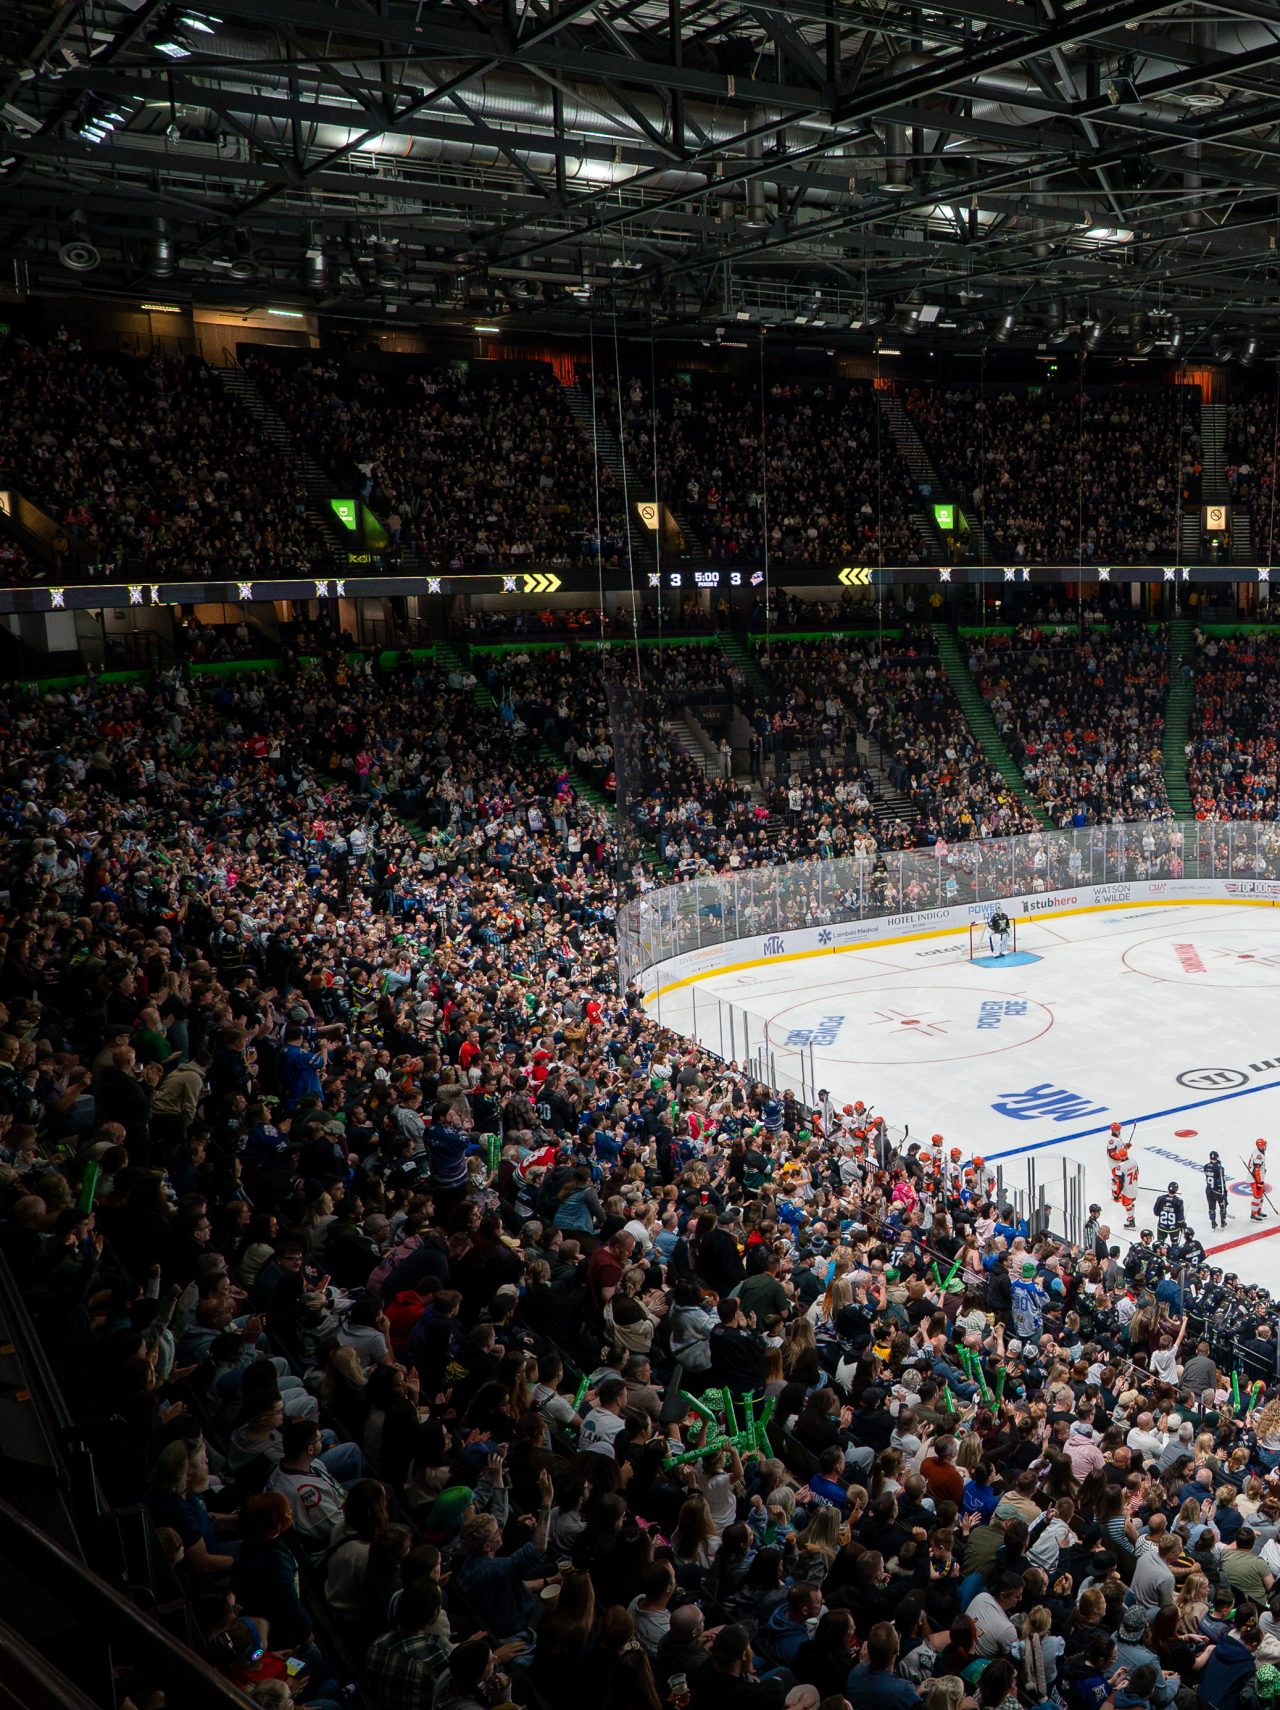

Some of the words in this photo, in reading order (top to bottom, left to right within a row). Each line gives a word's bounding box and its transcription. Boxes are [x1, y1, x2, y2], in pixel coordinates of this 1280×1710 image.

[670, 574, 682, 587] 3
[695, 572, 720, 582] 5:00
[730, 573, 741, 586] 3
[1093, 885, 1131, 896] WATSON
[1030, 895, 1078, 911] stubhero
[1094, 895, 1101, 903] &
[1103, 893, 1131, 903] WILDE
[887, 915, 916, 926] HOTEL
[917, 910, 950, 922] INDIGO
[833, 930, 857, 938] Lambda
[857, 926, 879, 934] Medical
[763, 935, 785, 956] MTK
[990, 1083, 1108, 1122] MTK
[1160, 1211, 1176, 1225] 29
